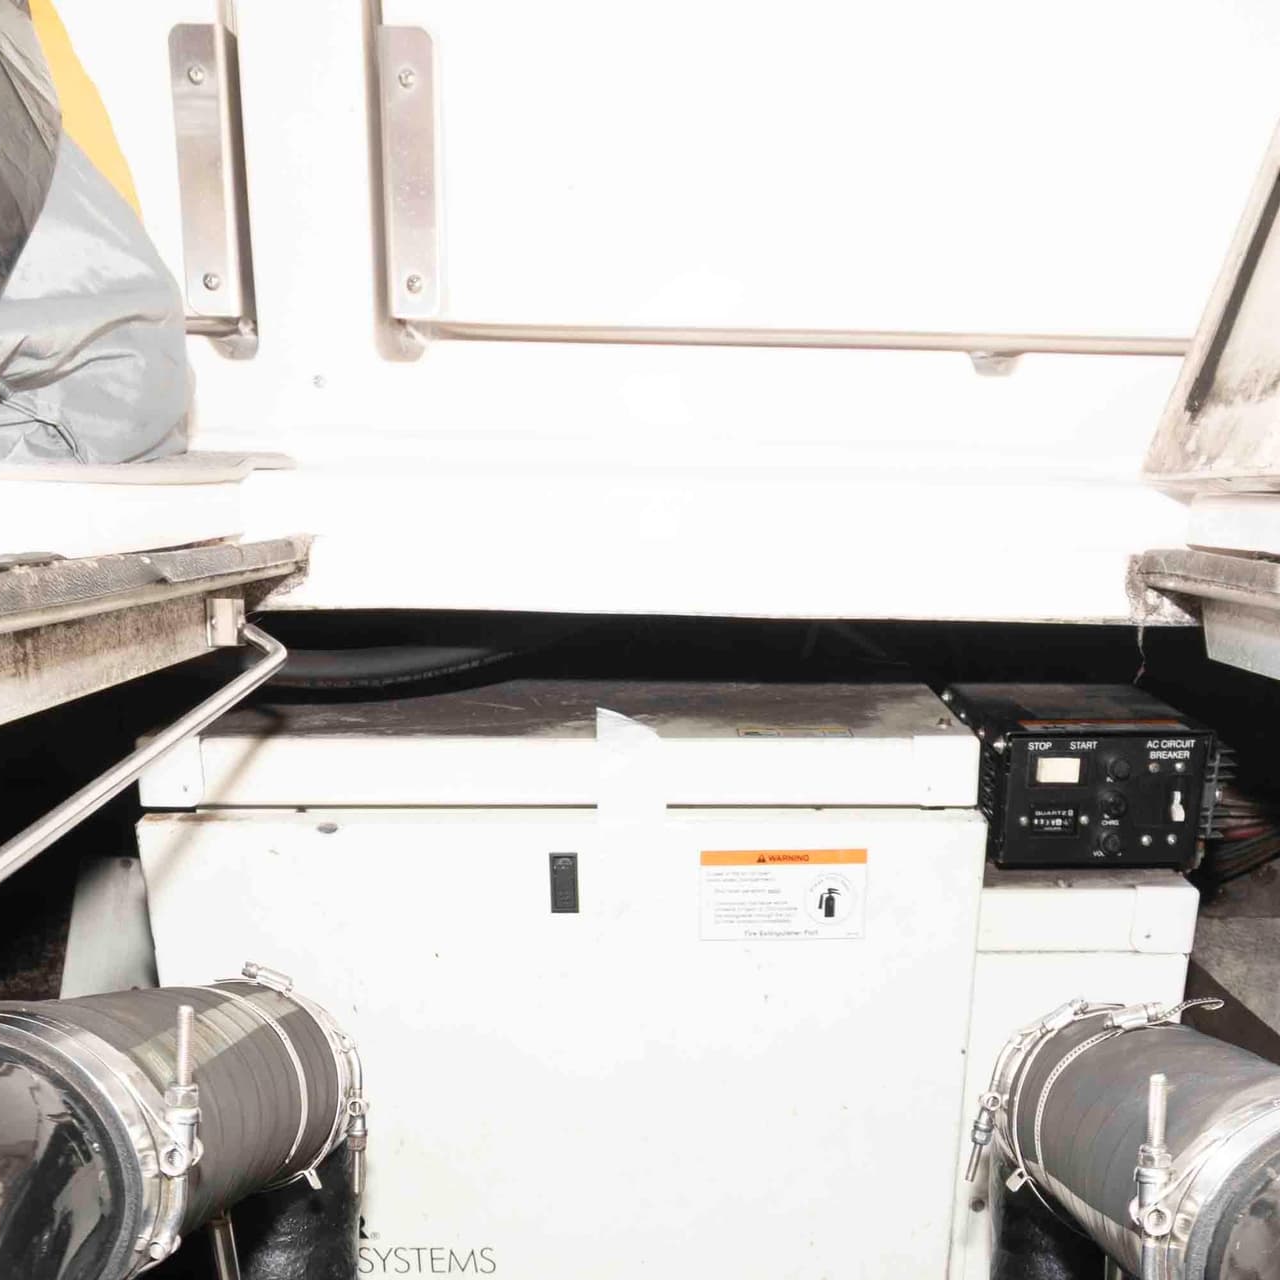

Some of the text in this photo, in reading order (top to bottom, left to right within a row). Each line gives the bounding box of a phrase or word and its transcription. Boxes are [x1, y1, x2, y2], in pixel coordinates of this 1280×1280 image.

[1027, 741, 1053, 751] STOP
[1069, 740, 1099, 751] START
[1146, 739, 1196, 749] AC CIRCUIT
[1149, 750, 1191, 760] BREAKER
[1034, 809, 1067, 817] QUARTZ
[768, 853, 810, 863] WARNING
[357, 1246, 497, 1275] SYSTEMS
